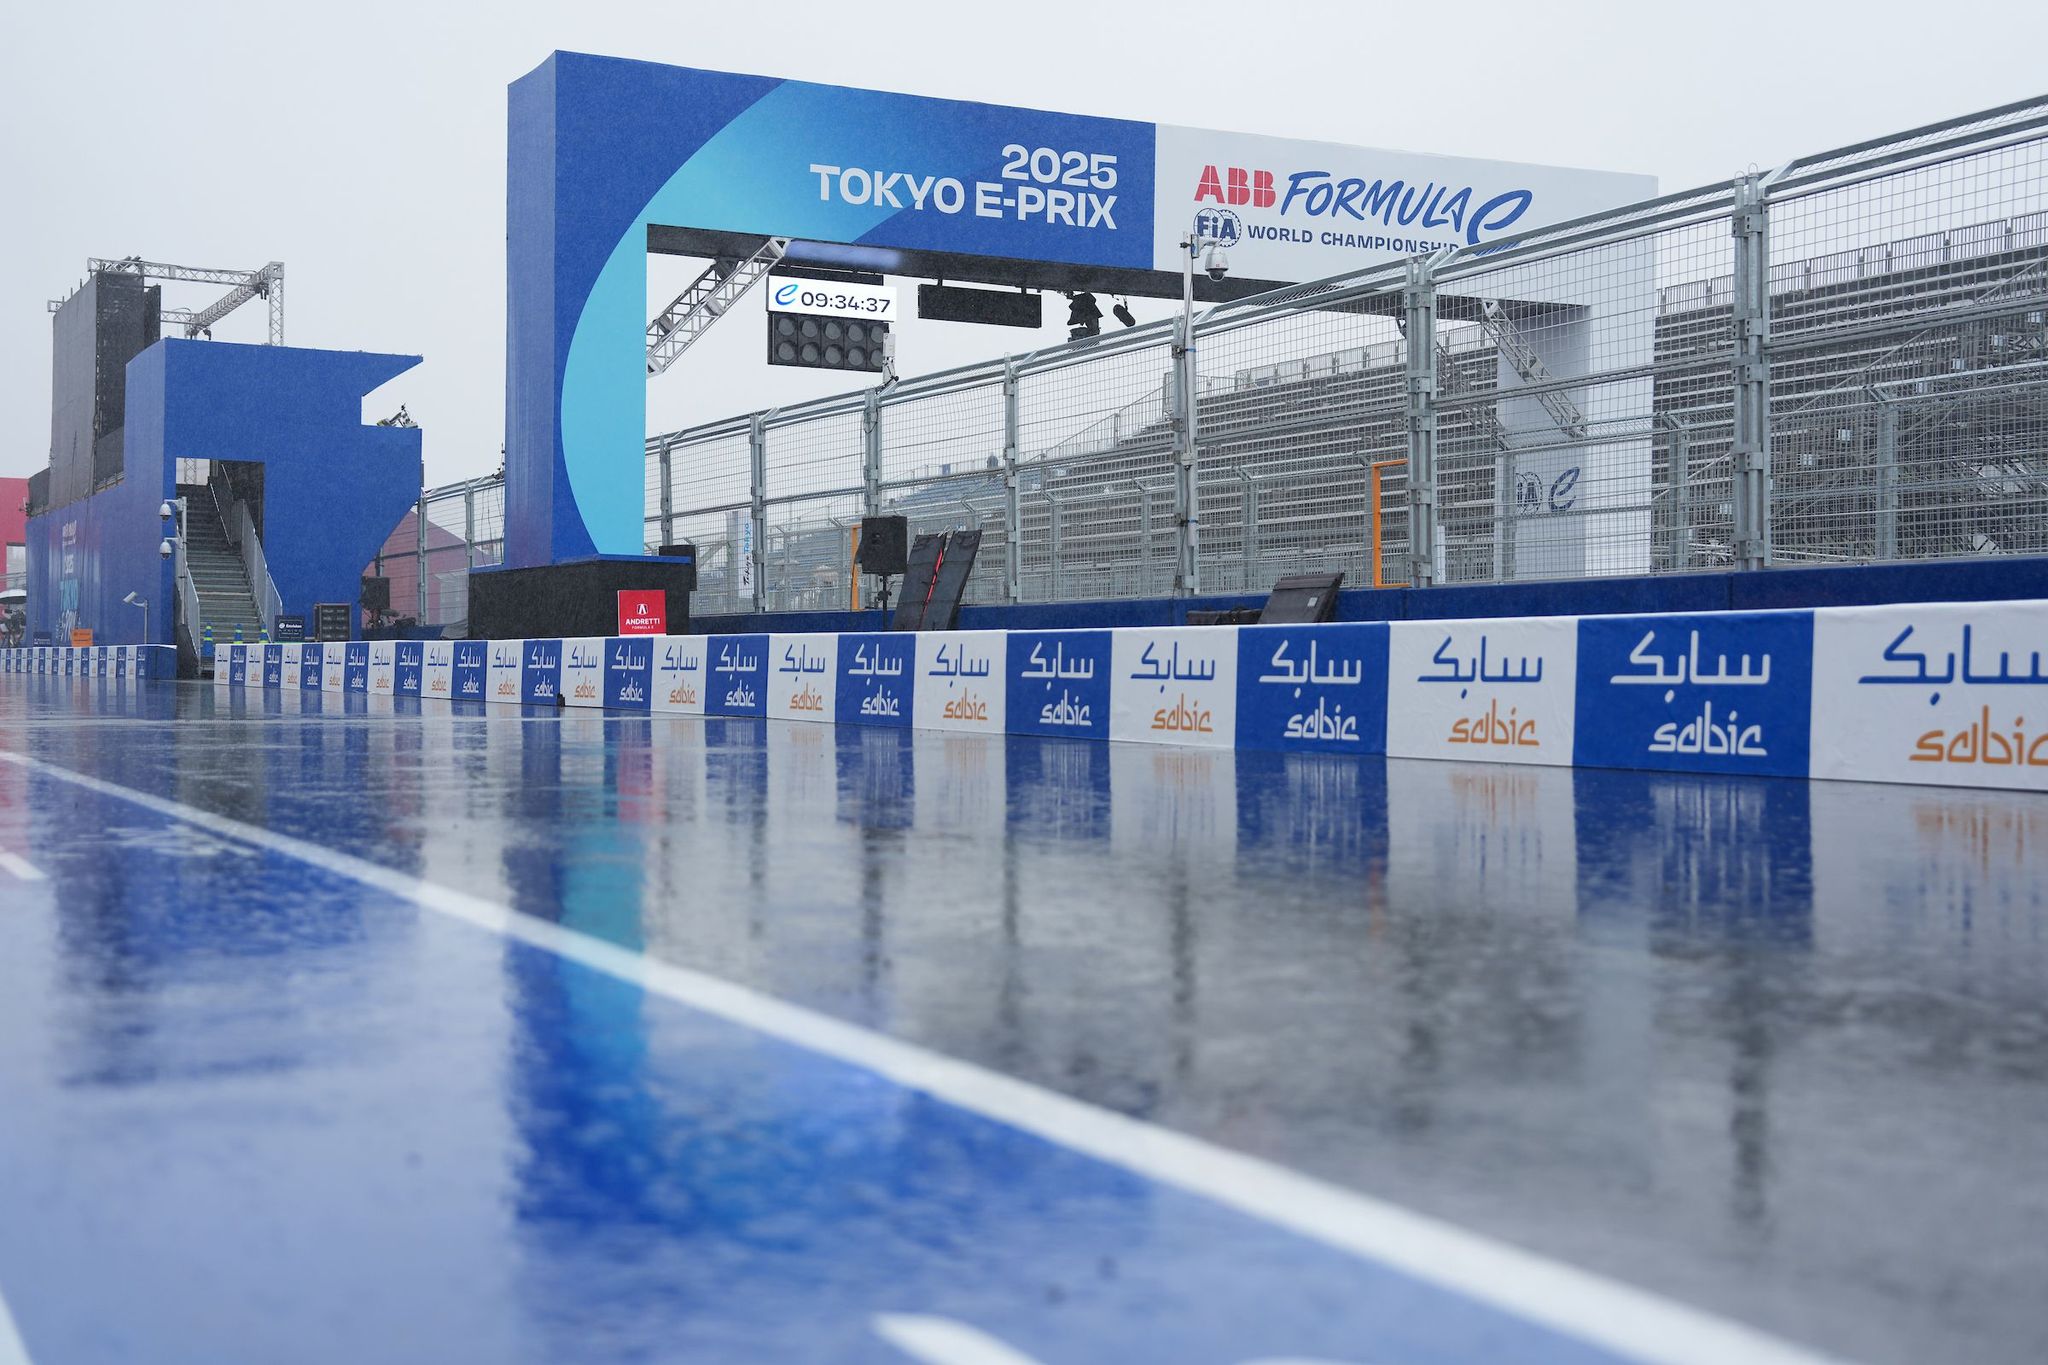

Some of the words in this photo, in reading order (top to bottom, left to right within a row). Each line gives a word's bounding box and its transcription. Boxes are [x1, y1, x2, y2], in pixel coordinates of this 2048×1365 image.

[1001, 144, 1118, 190] 2025
[809, 163, 965, 214] TOKYO
[975, 181, 1118, 230] E-PRIX
[1194, 165, 1277, 208] ABB
[1280, 171, 1472, 233] FORMULA
[1248, 225, 1313, 243] WORLD
[801, 291, 891, 313] 09:34:37
[497, 676, 515, 695] sabic
[534, 678, 554, 697] sabic
[574, 680, 595, 698] sabic
[619, 681, 643, 702] sabic
[669, 680, 696, 704] sabic
[724, 680, 755, 707] sabic
[790, 680, 823, 711] sabic
[860, 685, 900, 716] sabic
[943, 687, 988, 721] sabic
[1039, 689, 1092, 726] sabic
[1151, 693, 1213, 732] sabic
[1284, 696, 1360, 741] sabic
[1448, 698, 1540, 746] sabic
[1648, 701, 1767, 756] sabic
